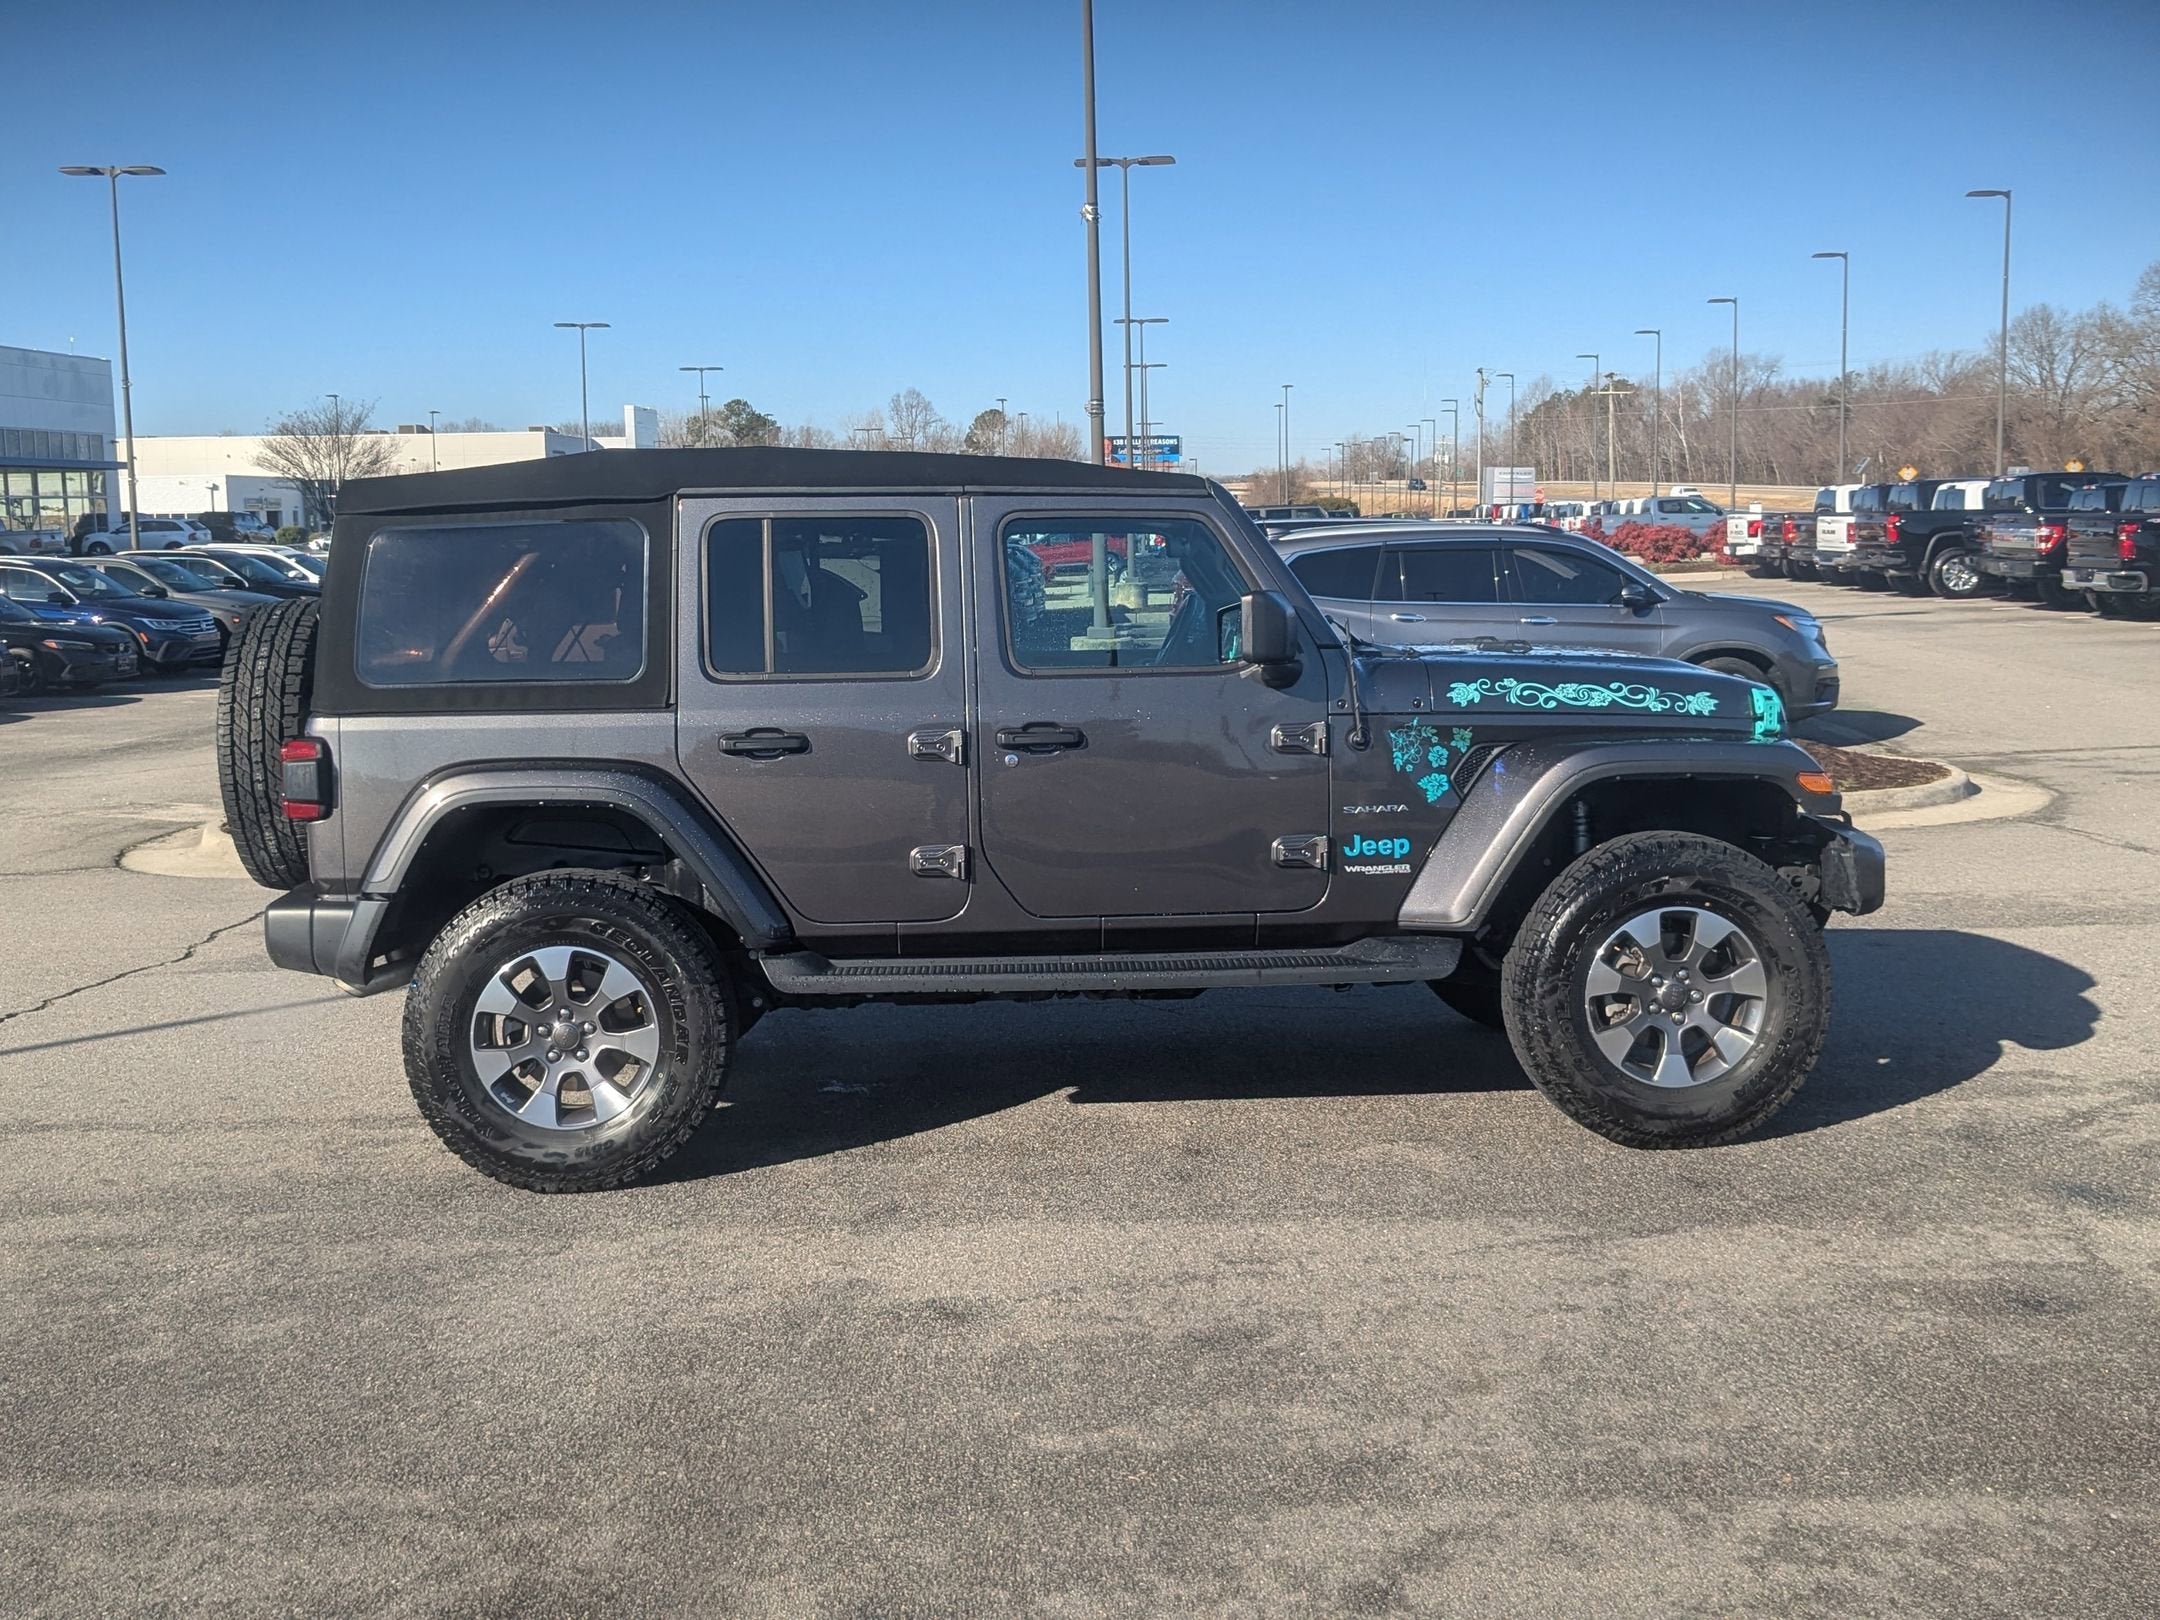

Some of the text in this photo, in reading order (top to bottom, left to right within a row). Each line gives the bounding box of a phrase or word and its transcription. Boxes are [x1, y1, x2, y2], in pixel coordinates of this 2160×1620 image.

[1343, 803, 1410, 814] SAHARA
[1343, 833, 1411, 860] Jeep
[1343, 863, 1412, 874] WRANGLER
[589, 920, 690, 1067] GEOLANDAR
